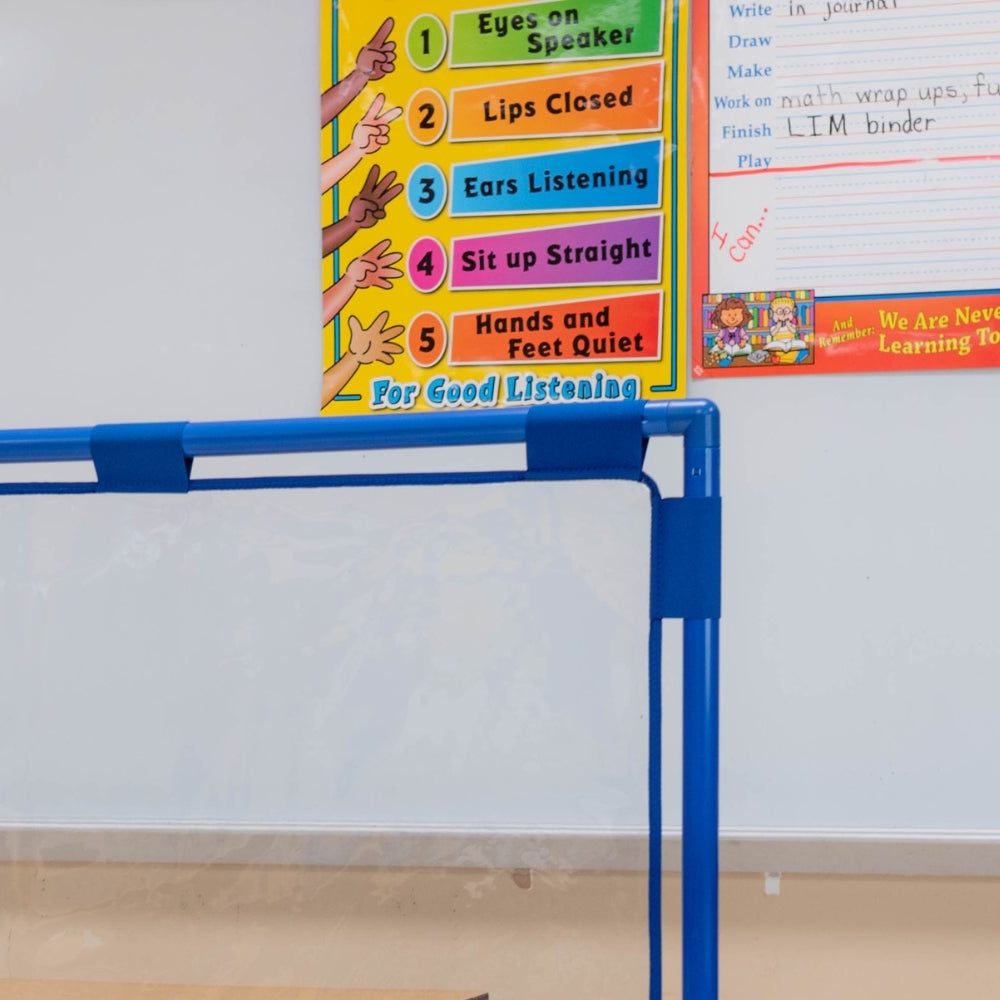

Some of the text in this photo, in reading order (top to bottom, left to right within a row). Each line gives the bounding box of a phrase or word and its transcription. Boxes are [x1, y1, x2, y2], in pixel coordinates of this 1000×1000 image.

[478, 8, 579, 37] Eyes on
[730, 4, 772, 17] Write
[420, 29, 431, 54] 1
[527, 25, 634, 55] Speaker
[728, 35, 772, 48] Draw
[727, 65, 772, 79] Make
[483, 85, 633, 123] Lips Closed
[714, 96, 772, 109] Work on
[781, 83, 844, 108] math
[856, 87, 908, 107] wrap
[919, 86, 968, 106] ups,
[419, 103, 435, 129] 2
[787, 109, 936, 137] LIM binder
[722, 125, 772, 139] Finish
[737, 154, 772, 169] Play
[419, 178, 435, 203] 3
[464, 163, 648, 198] Ears Listening
[417, 251, 434, 276] 4
[461, 238, 652, 272] Sit up Straight
[476, 306, 610, 335] Hands and
[832, 315, 853, 333] And
[878, 309, 908, 330] We
[913, 311, 949, 330] Are
[419, 327, 435, 353] 5
[508, 331, 644, 359] Feet Quiet
[818, 326, 876, 349] Remember:
[878, 333, 972, 357] Learning
[373, 371, 638, 405] For Good Listening
